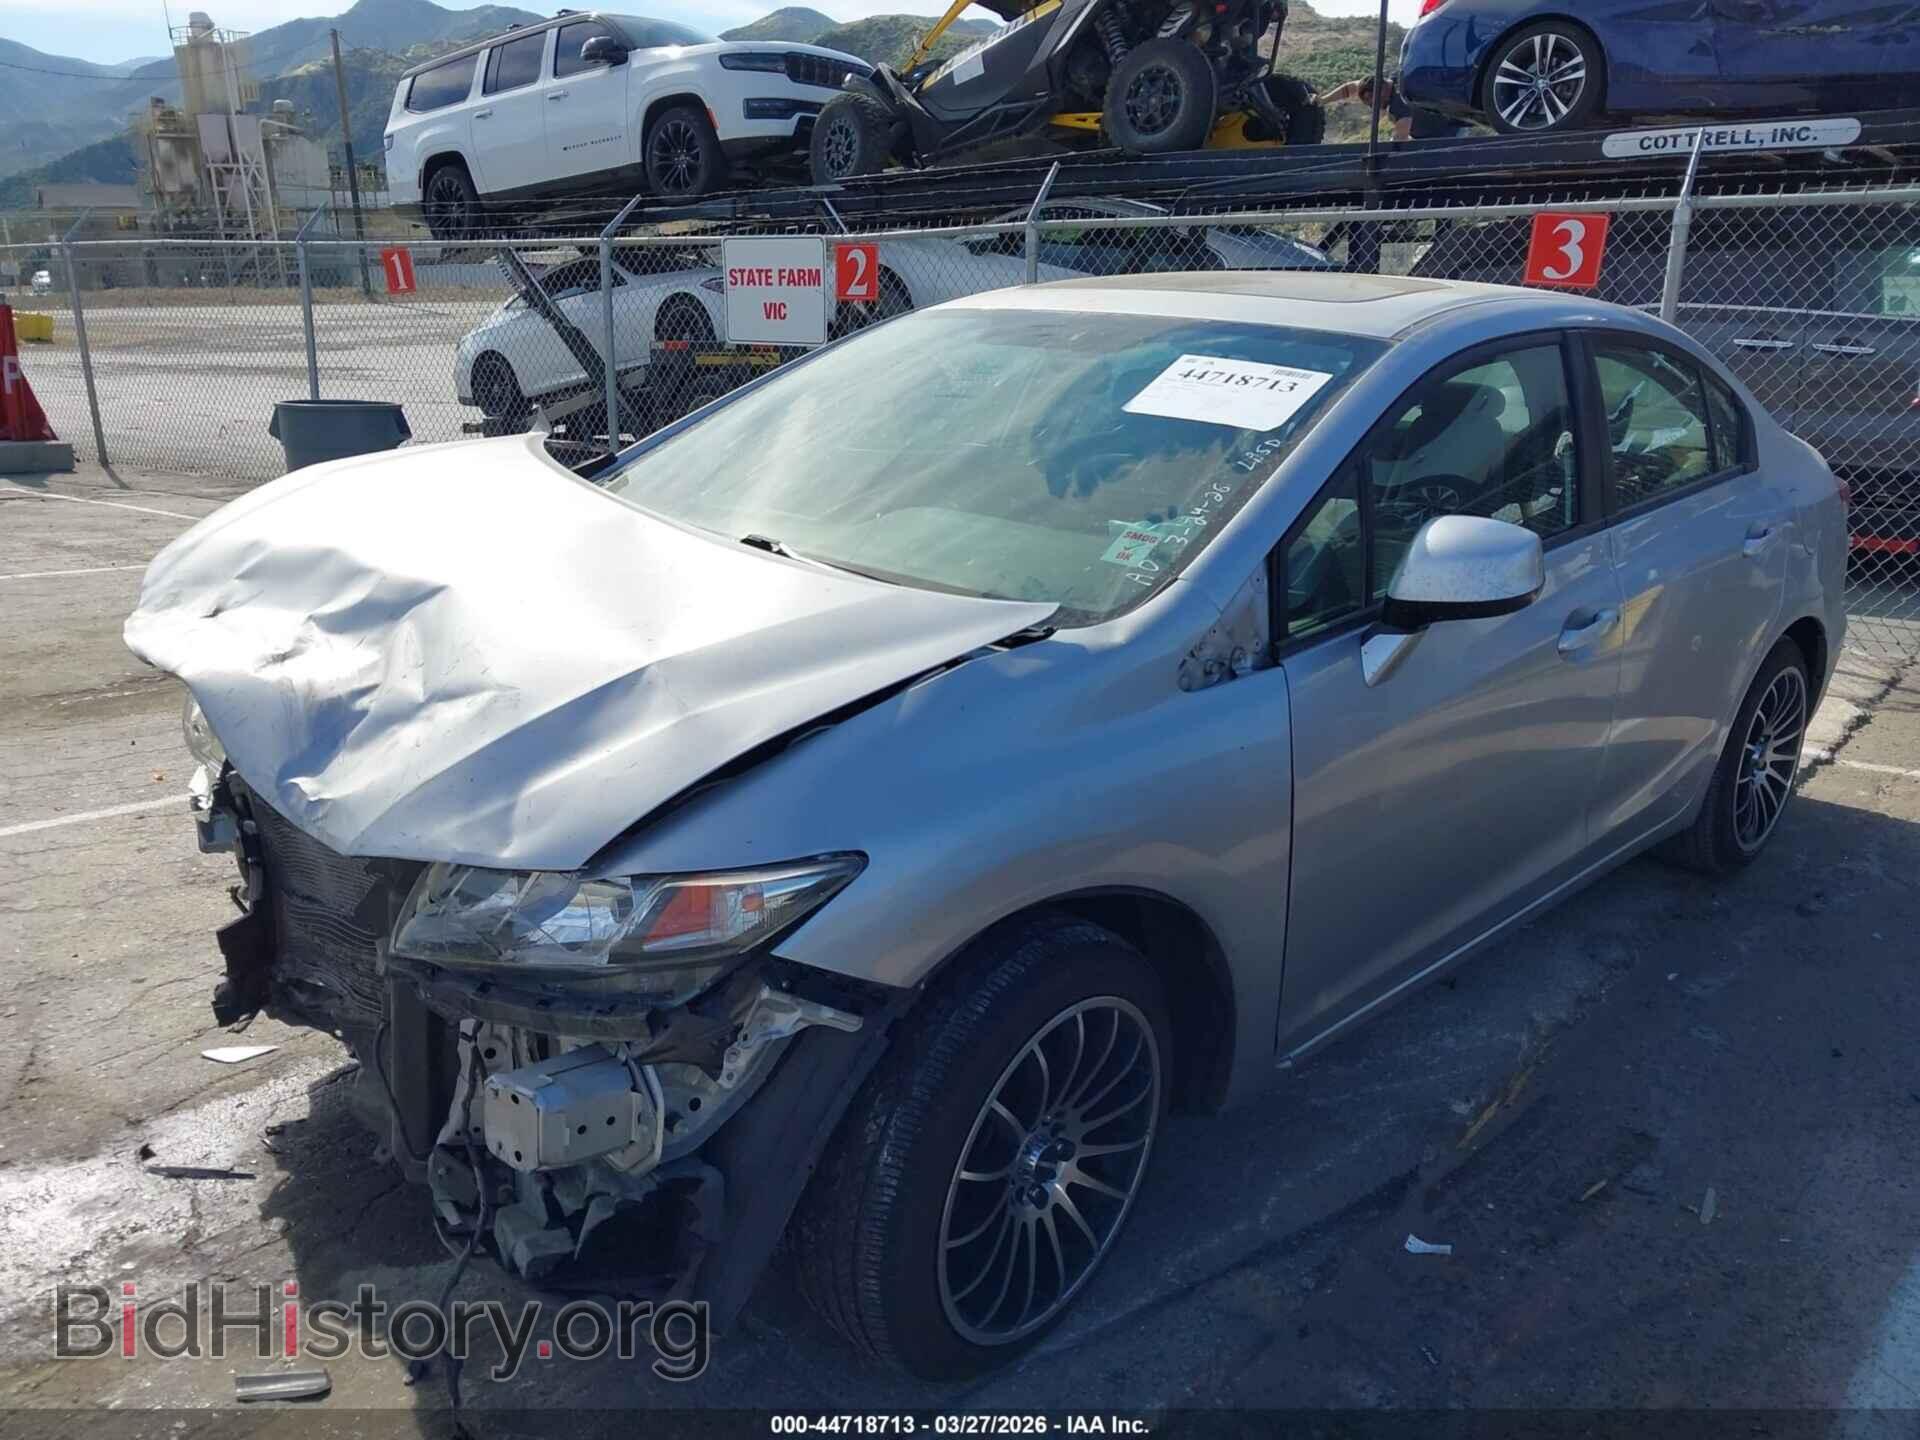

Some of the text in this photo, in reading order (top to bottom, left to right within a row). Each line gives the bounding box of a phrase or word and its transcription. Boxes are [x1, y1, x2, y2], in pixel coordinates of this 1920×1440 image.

[1638, 125, 1818, 151] COTTRELL, INC.
[1542, 220, 1585, 280] 3
[390, 252, 409, 289] 1
[729, 268, 821, 287] STATE FARM
[846, 248, 868, 295] 2
[763, 302, 787, 320] VIC
[1178, 367, 1299, 393] 44718713
